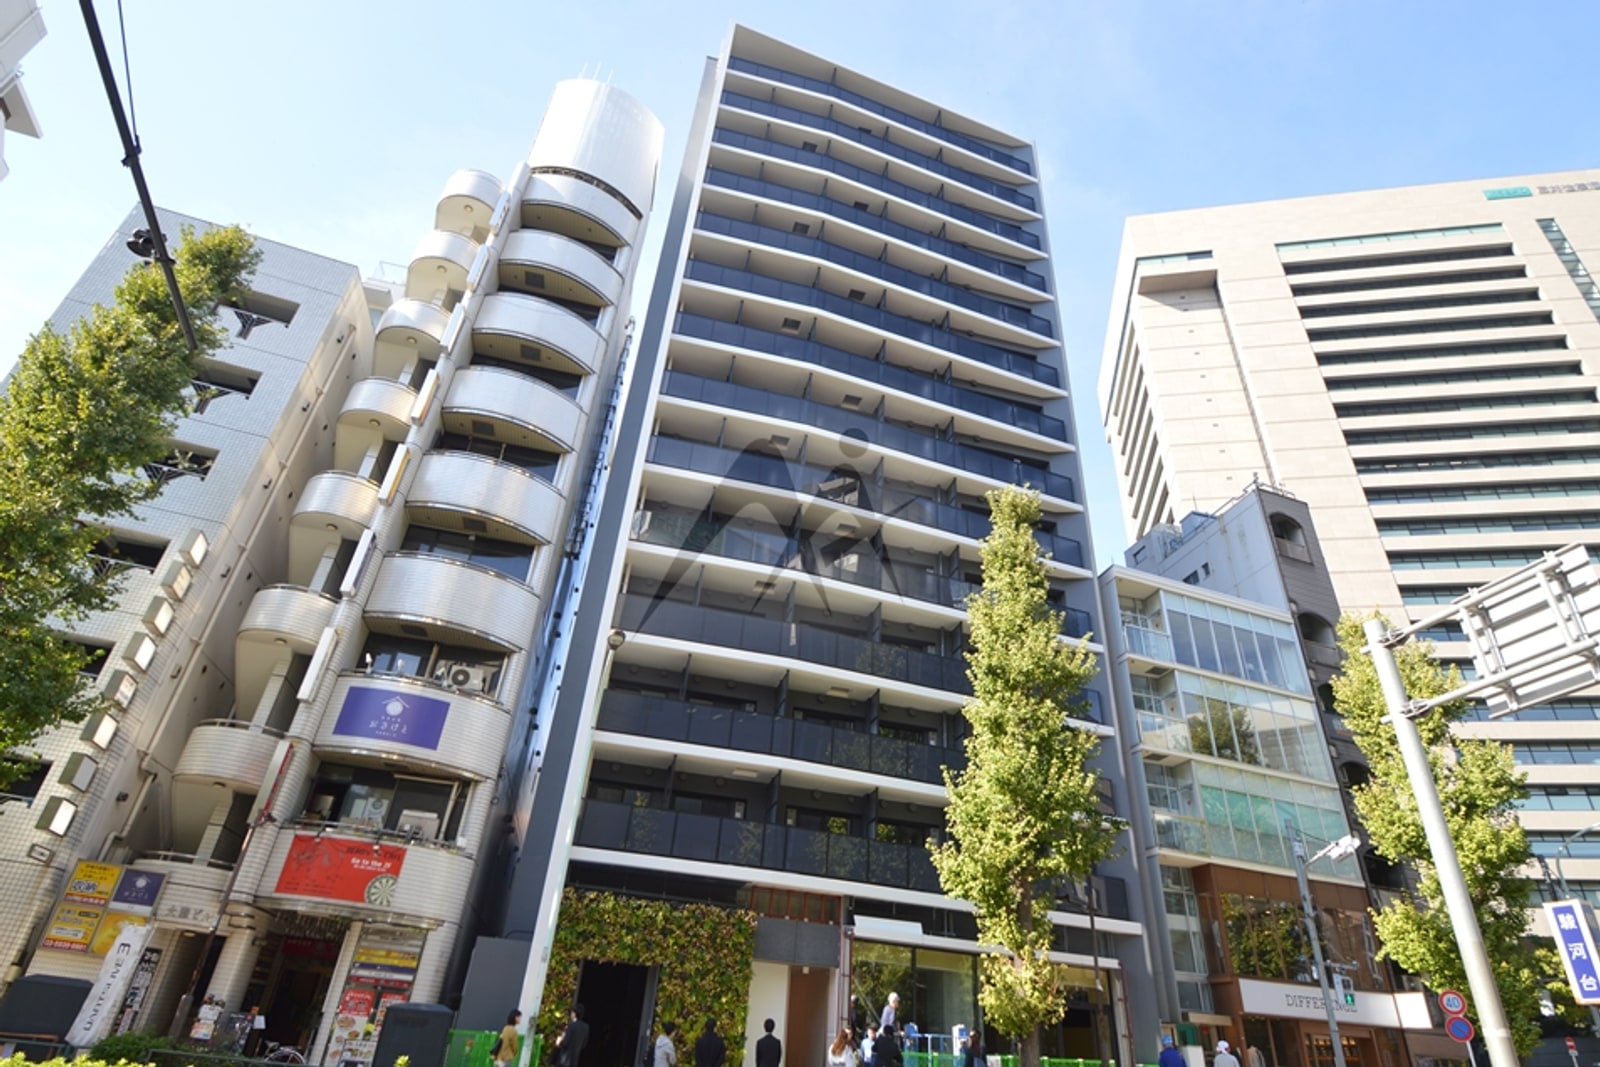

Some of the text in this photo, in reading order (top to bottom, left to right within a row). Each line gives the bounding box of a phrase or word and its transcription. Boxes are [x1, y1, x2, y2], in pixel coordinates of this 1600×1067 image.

[1557, 912, 1598, 991] 駿河台
[1284, 993, 1358, 1013] DIFFERNCE
[1445, 996, 1461, 1009] 40
